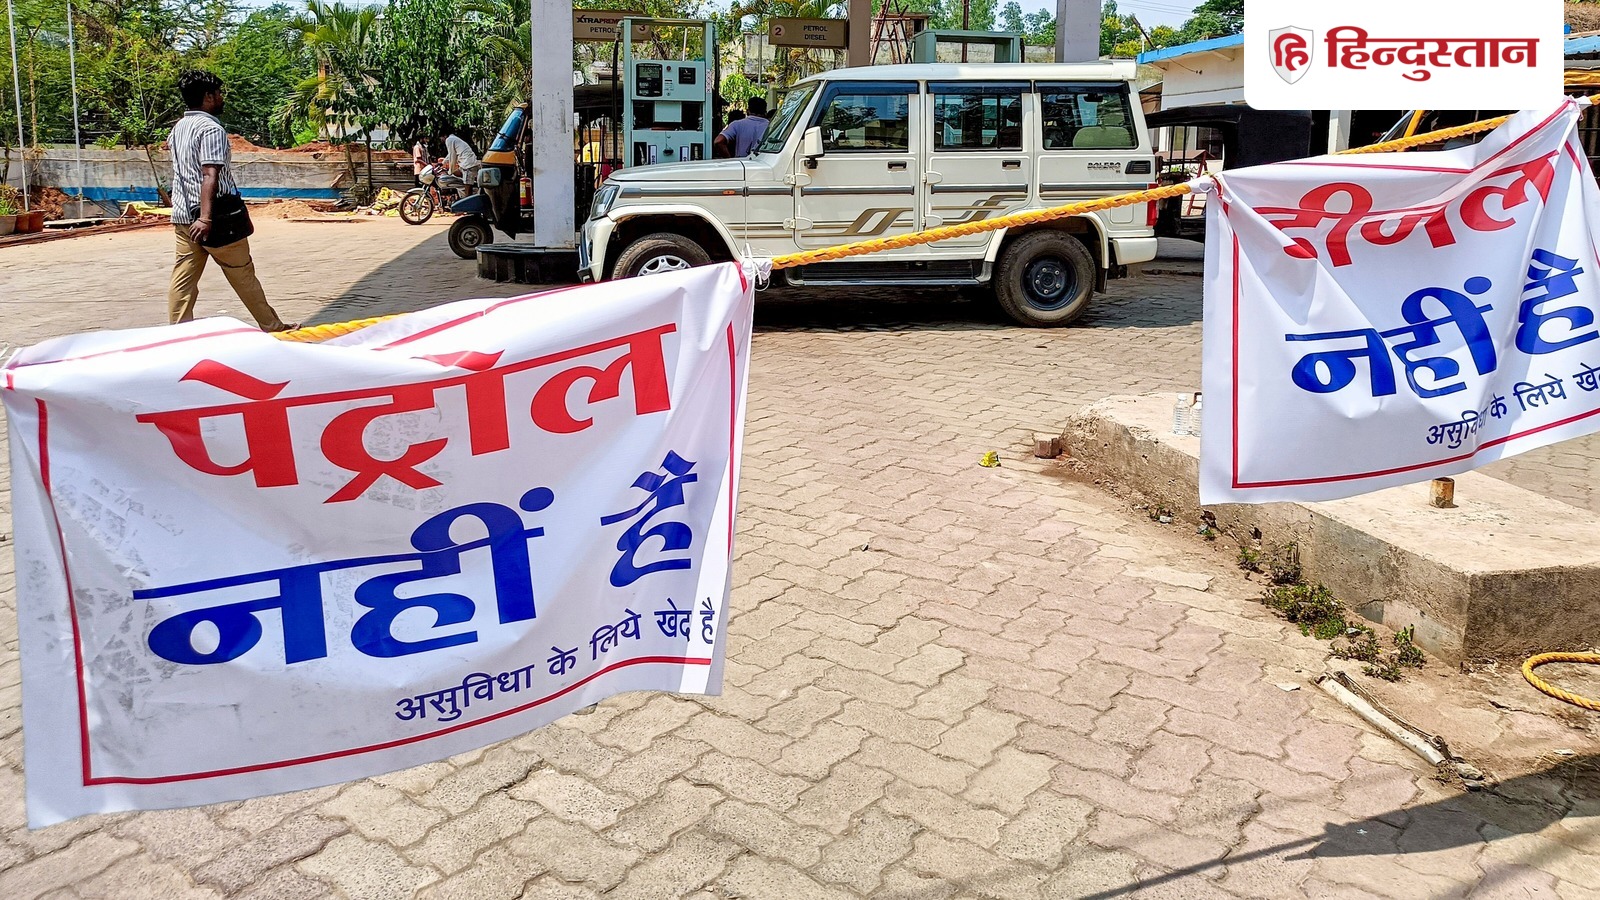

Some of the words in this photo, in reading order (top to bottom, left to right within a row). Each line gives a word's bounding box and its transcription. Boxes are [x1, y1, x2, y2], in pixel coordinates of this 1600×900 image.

[775, 27, 782, 36] 2
[1087, 162, 1121, 170] BOLERO
[1252, 149, 1560, 268] डीजल
[1285, 276, 1494, 399] नहीं
[1514, 248, 1600, 355] है
[136, 322, 677, 504] पेट्रोल
[1426, 410, 1488, 449] असुविधा
[1490, 393, 1507, 419] के
[1513, 373, 1567, 411] लिये
[1572, 362, 1600, 392] खे
[133, 486, 555, 665] नहीं
[600, 450, 698, 588] है
[395, 664, 535, 722] असुविधा
[547, 646, 578, 675] के
[589, 608, 642, 660] लिये
[653, 597, 692, 642] खेद
[700, 596, 715, 645] है
